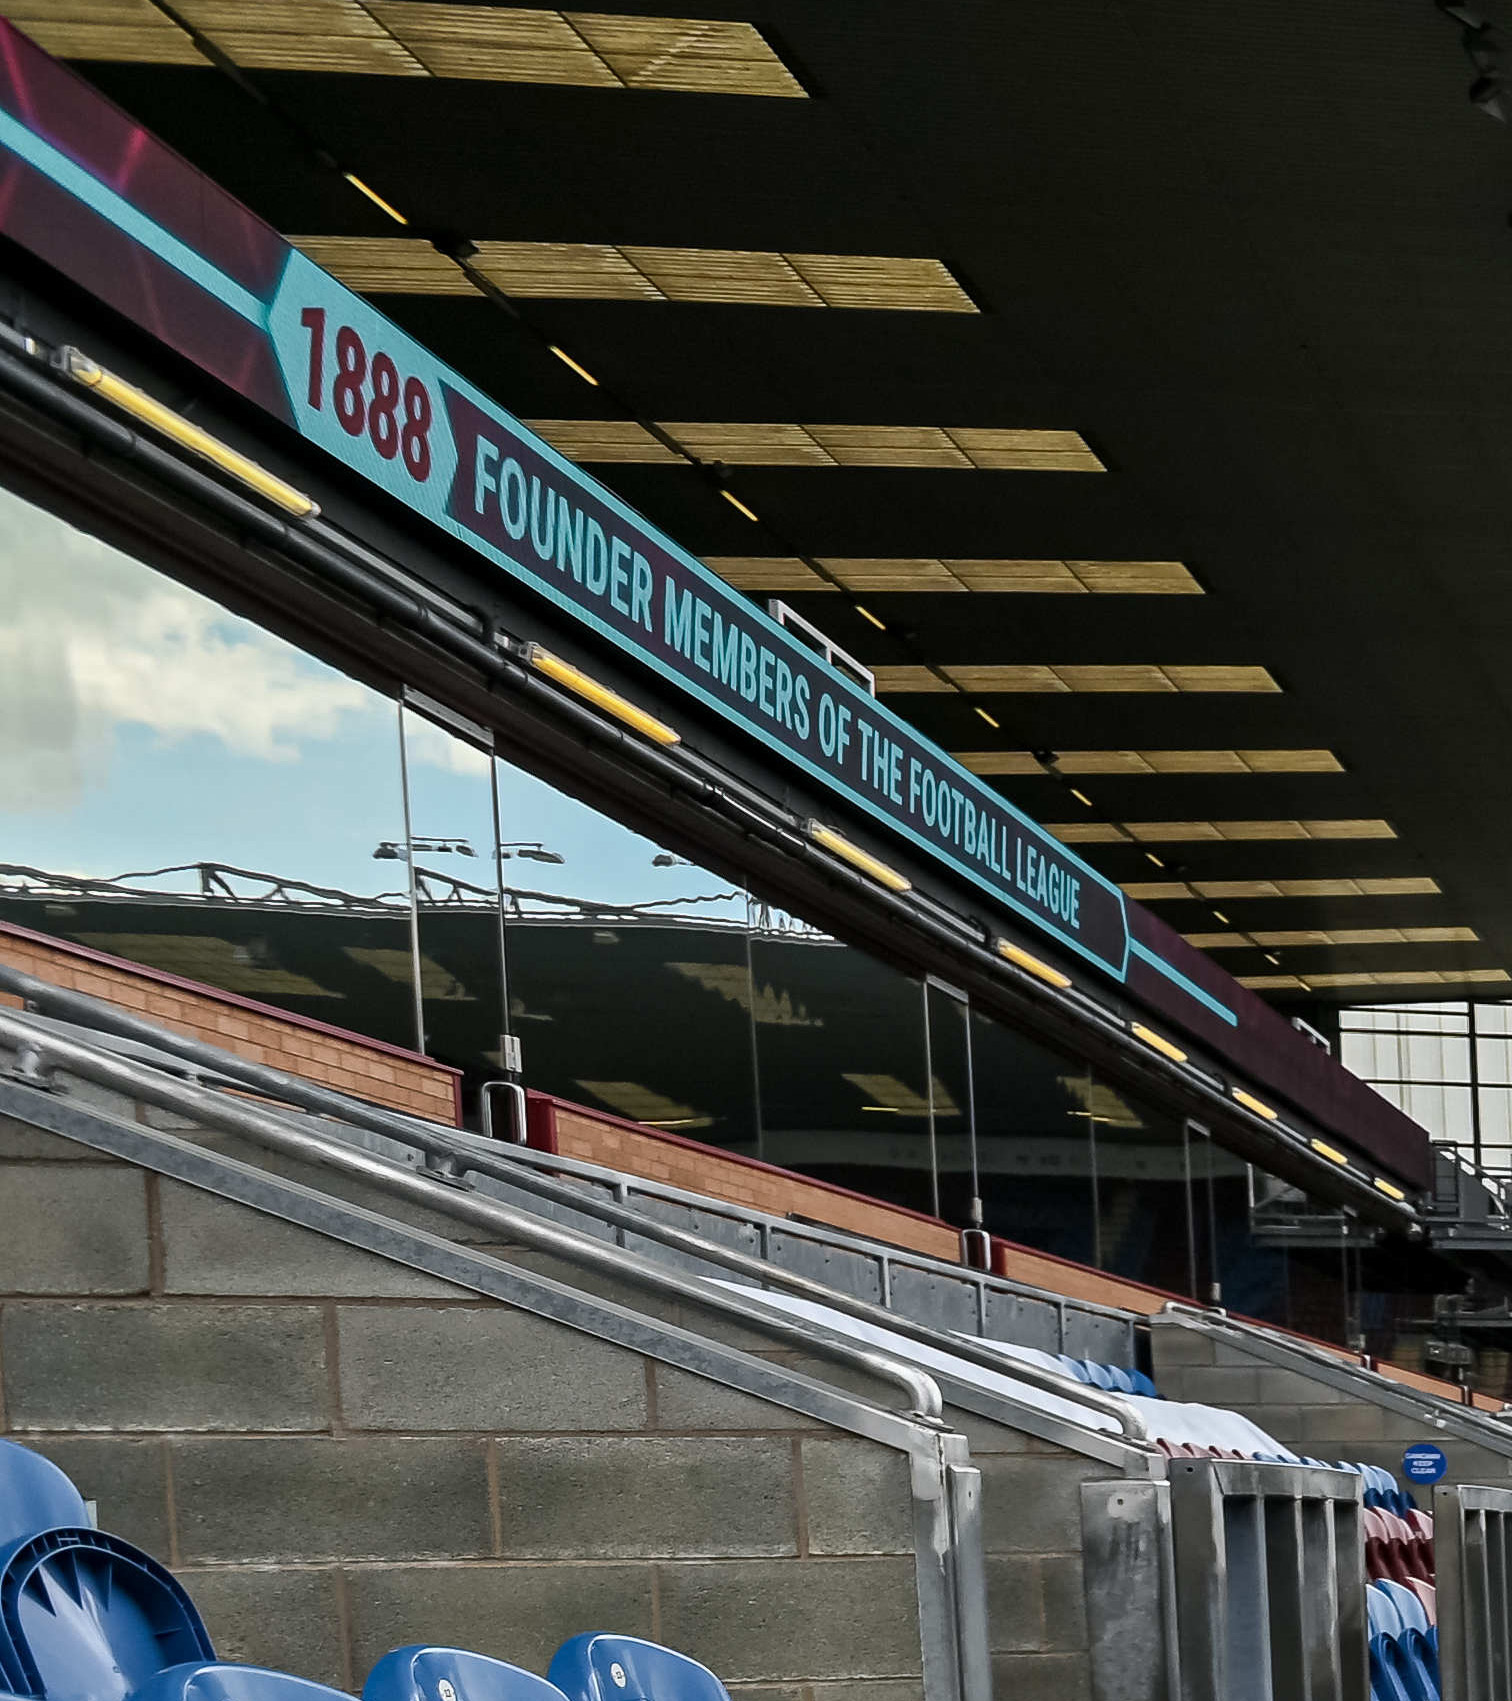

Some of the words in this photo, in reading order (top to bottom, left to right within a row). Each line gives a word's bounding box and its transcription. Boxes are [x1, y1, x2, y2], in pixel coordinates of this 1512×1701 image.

[301, 307, 432, 483] 1888
[474, 434, 653, 633] FOUNDER
[664, 575, 811, 741] MEMBERS
[818, 693, 852, 765] OF
[857, 717, 904, 806] THE
[909, 757, 1012, 882] FOOTBALL
[1016, 837, 1081, 930] LEAGUE
